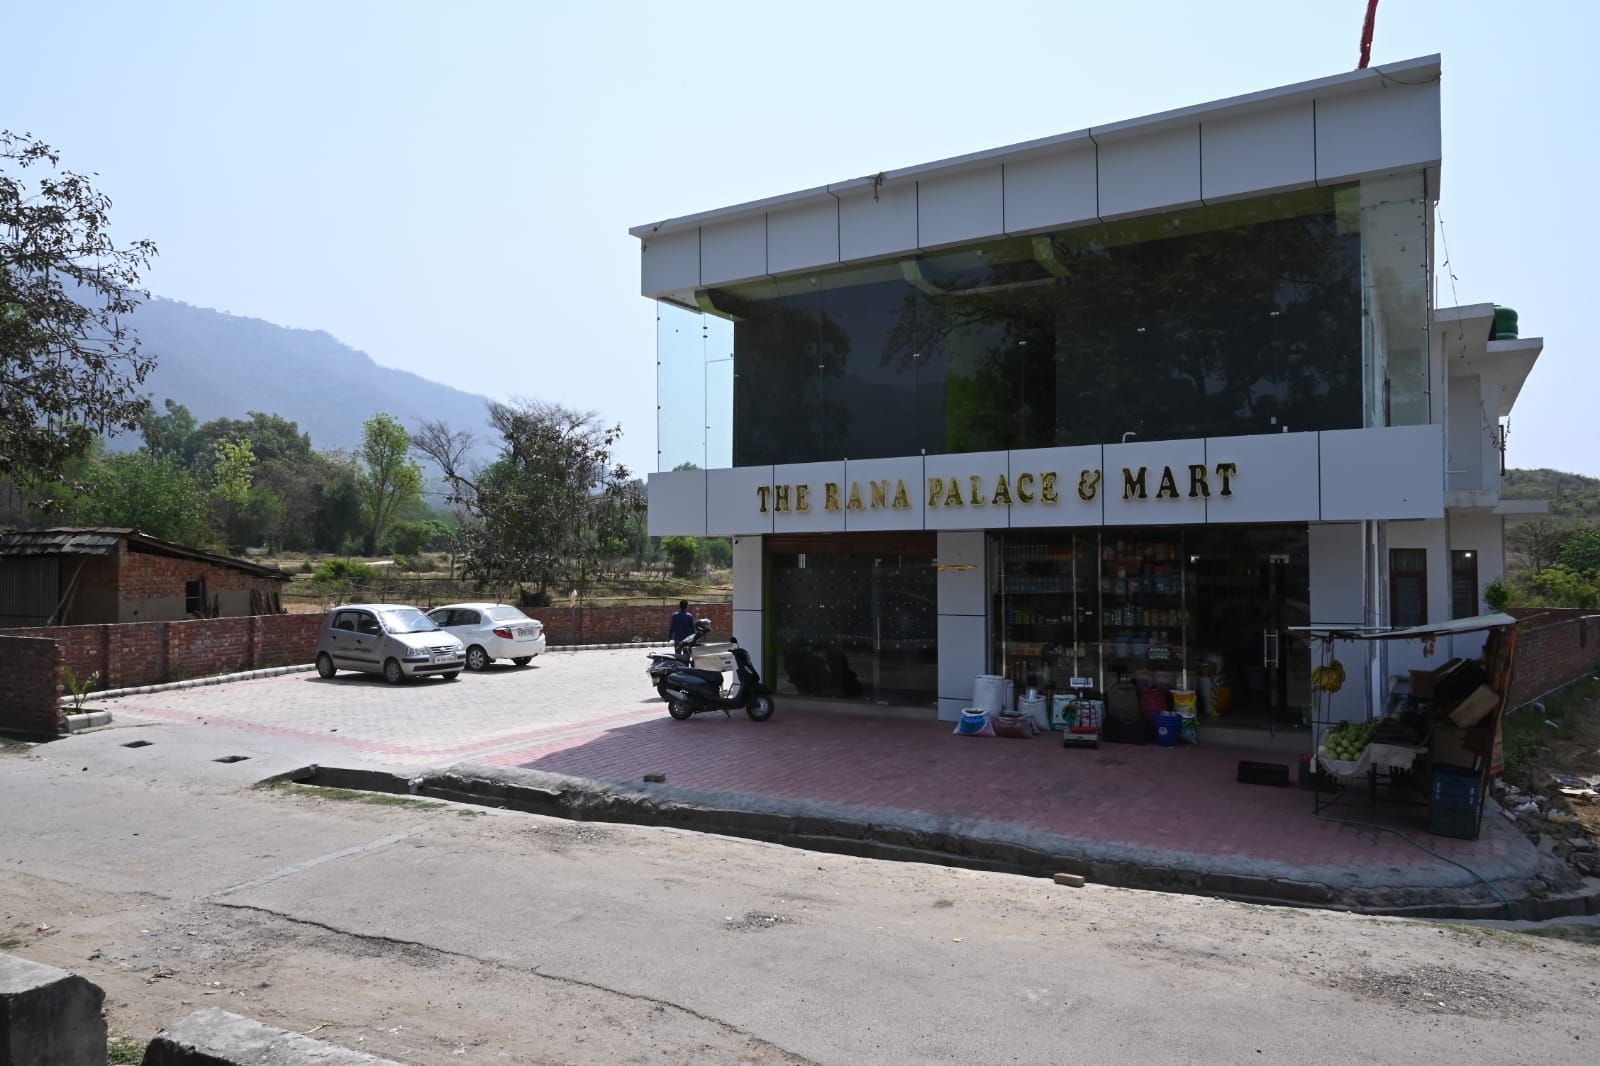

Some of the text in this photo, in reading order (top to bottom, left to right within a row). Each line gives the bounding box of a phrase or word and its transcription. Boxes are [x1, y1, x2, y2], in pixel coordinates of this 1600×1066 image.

[757, 462, 1237, 513] THE RANA PALACE & MART
